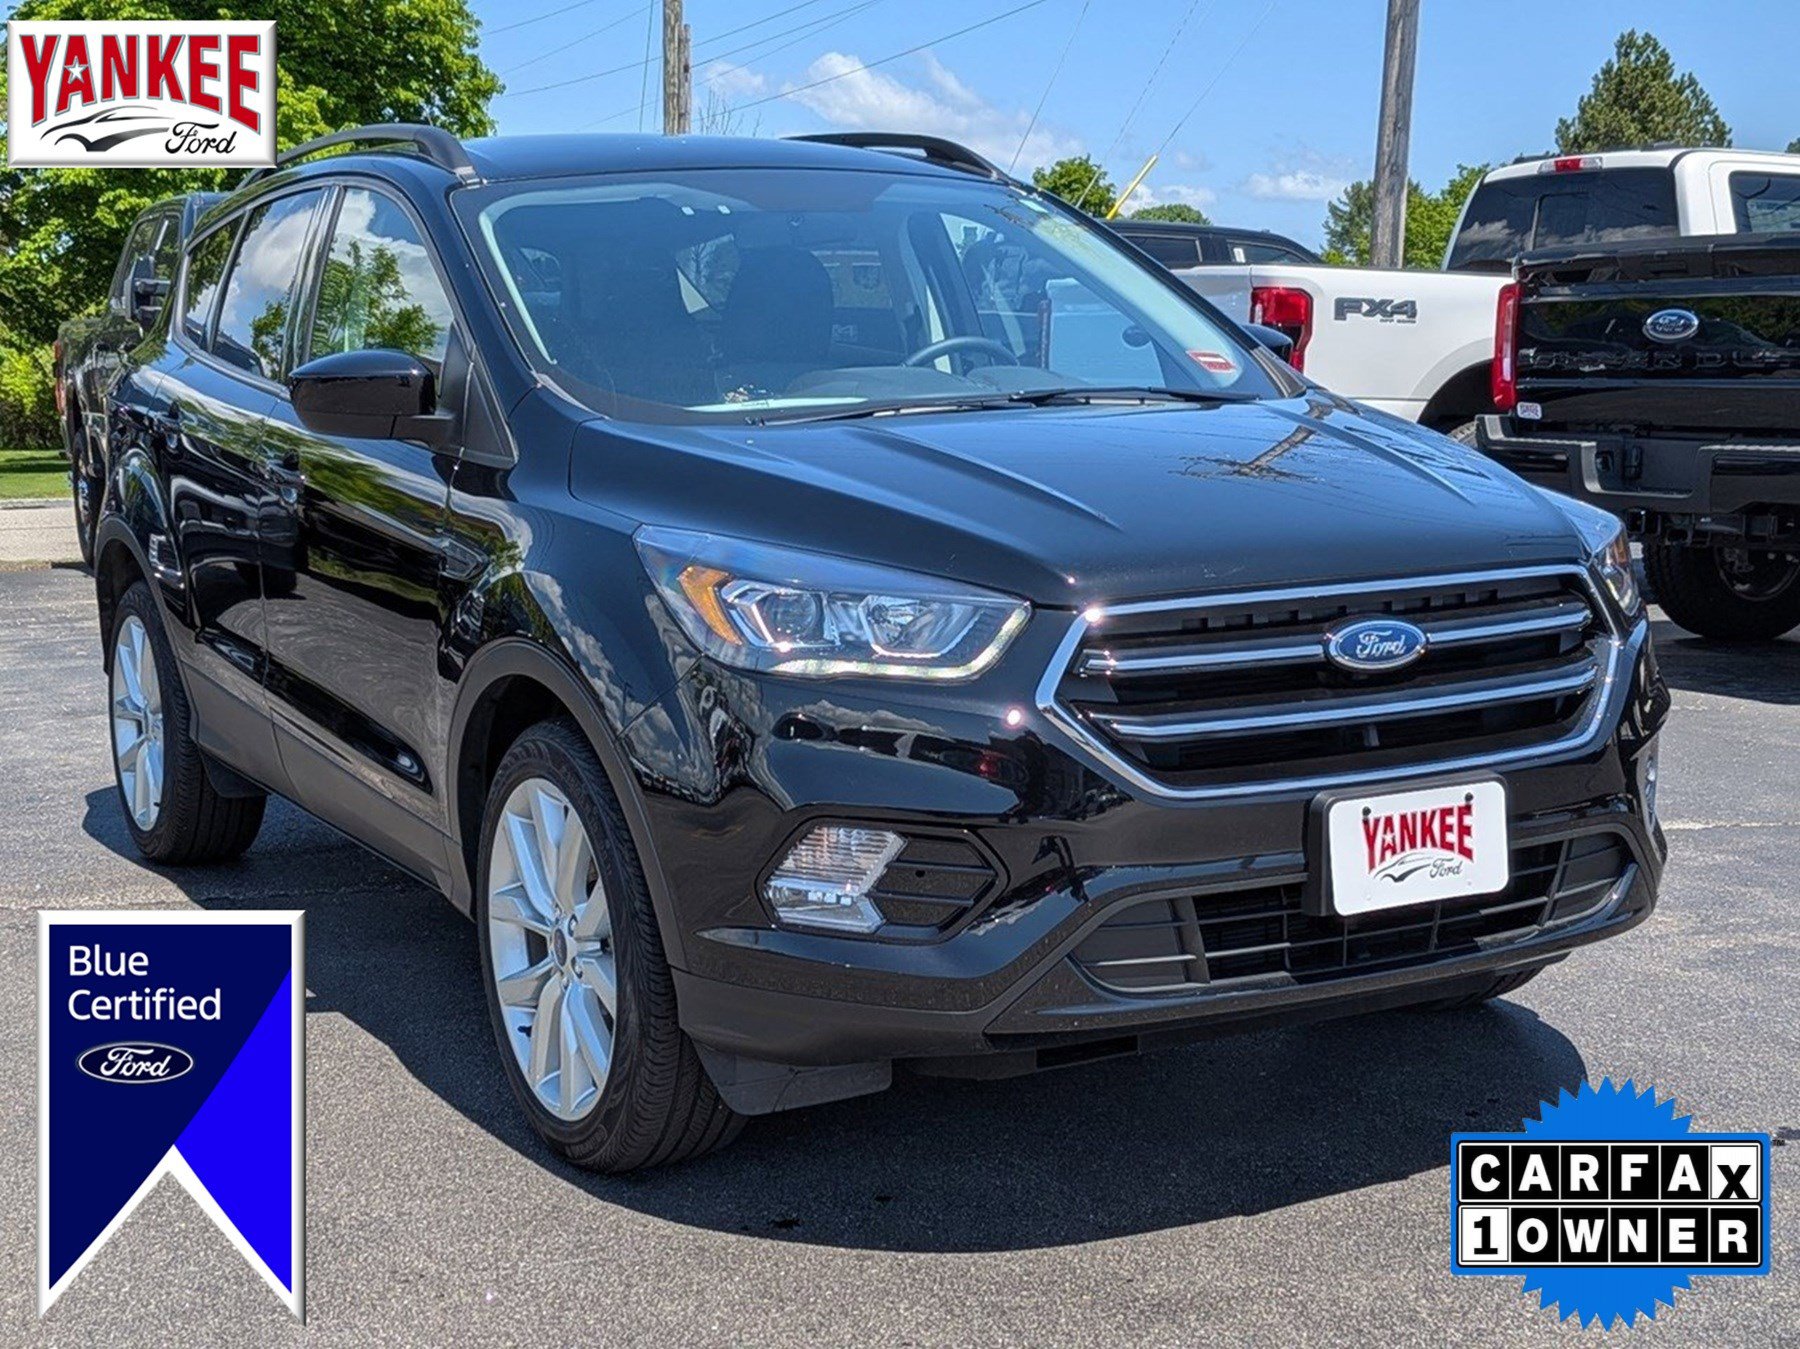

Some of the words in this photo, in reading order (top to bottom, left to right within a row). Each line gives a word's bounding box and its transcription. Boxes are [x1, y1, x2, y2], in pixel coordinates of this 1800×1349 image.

[1334, 297, 1417, 321] FX4
[1356, 630, 1406, 659] Ford
[1362, 803, 1474, 875] YANKEE
[1430, 857, 1463, 879] Ford
